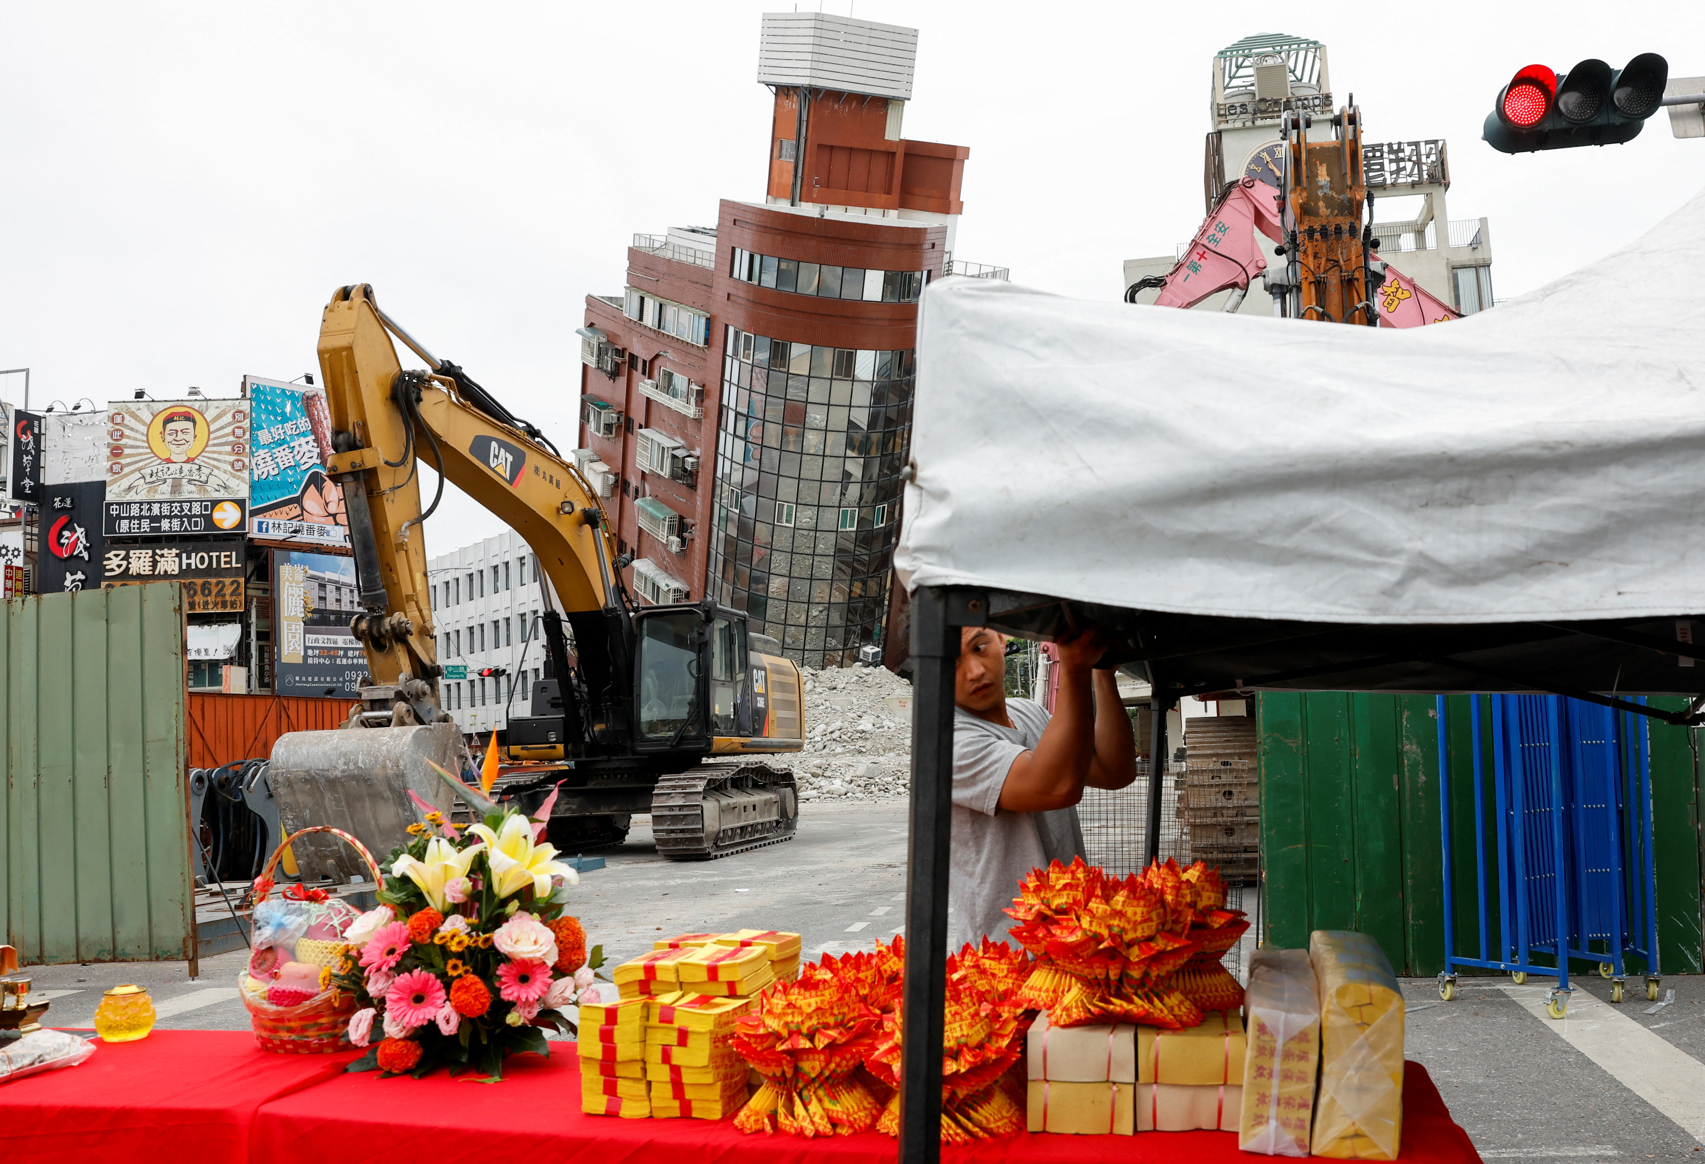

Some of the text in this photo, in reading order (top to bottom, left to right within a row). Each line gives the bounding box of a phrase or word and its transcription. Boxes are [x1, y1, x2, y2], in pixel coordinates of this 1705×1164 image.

[1217, 102, 1248, 117] Les
[1381, 277, 1412, 313] 智
[112, 414, 124, 472] 僅此一家
[233, 412, 244, 471] 別無分號
[258, 417, 312, 446] 最好吃的
[250, 435, 321, 481] 燒番麥
[489, 440, 513, 480] CAT
[53, 496, 73, 509] 花蓮
[110, 502, 211, 517] 中山路北濱街交叉路口
[103, 548, 242, 577] 多羅滿 HOTEL
[186, 580, 242, 598] 6622
[753, 668, 766, 693] CAT
